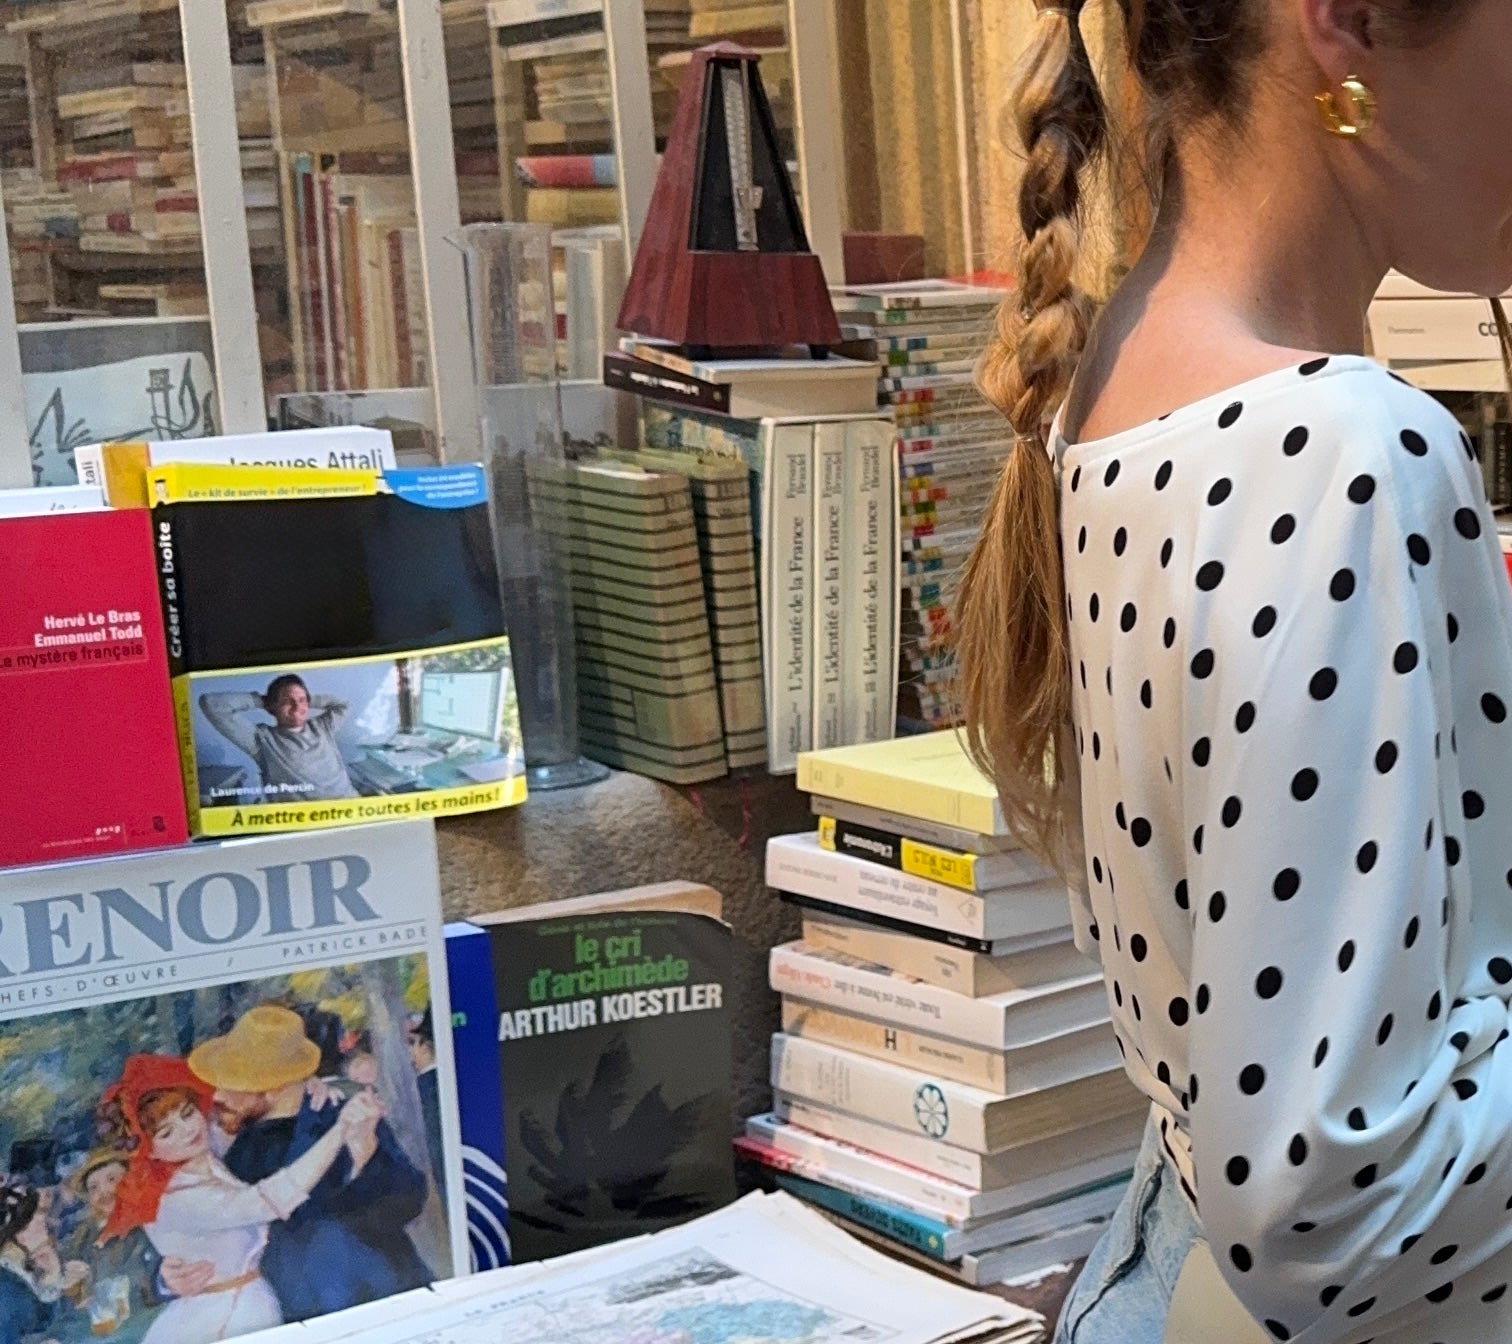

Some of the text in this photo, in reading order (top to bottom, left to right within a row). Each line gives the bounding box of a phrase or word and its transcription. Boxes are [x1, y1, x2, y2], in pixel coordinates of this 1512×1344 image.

[825, 506, 839, 560] France
[159, 521, 182, 658] Créer sa boîte
[788, 517, 804, 691] L'identité de la France
[44, 610, 141, 629] Hervé Le Bras
[34, 625, 143, 648] Emmanuel Todd
[16, 647, 78, 667] mystère
[80, 641, 144, 664] français
[247, 809, 305, 826] mettre
[309, 806, 354, 822] entre
[358, 802, 411, 819] toutes
[415, 796, 438, 812] les
[283, 925, 428, 958] PATRICK BADE
[575, 934, 598, 964] le
[529, 956, 688, 1001] d'archimède
[499, 984, 722, 1041] ARTHUR KOESTLER
